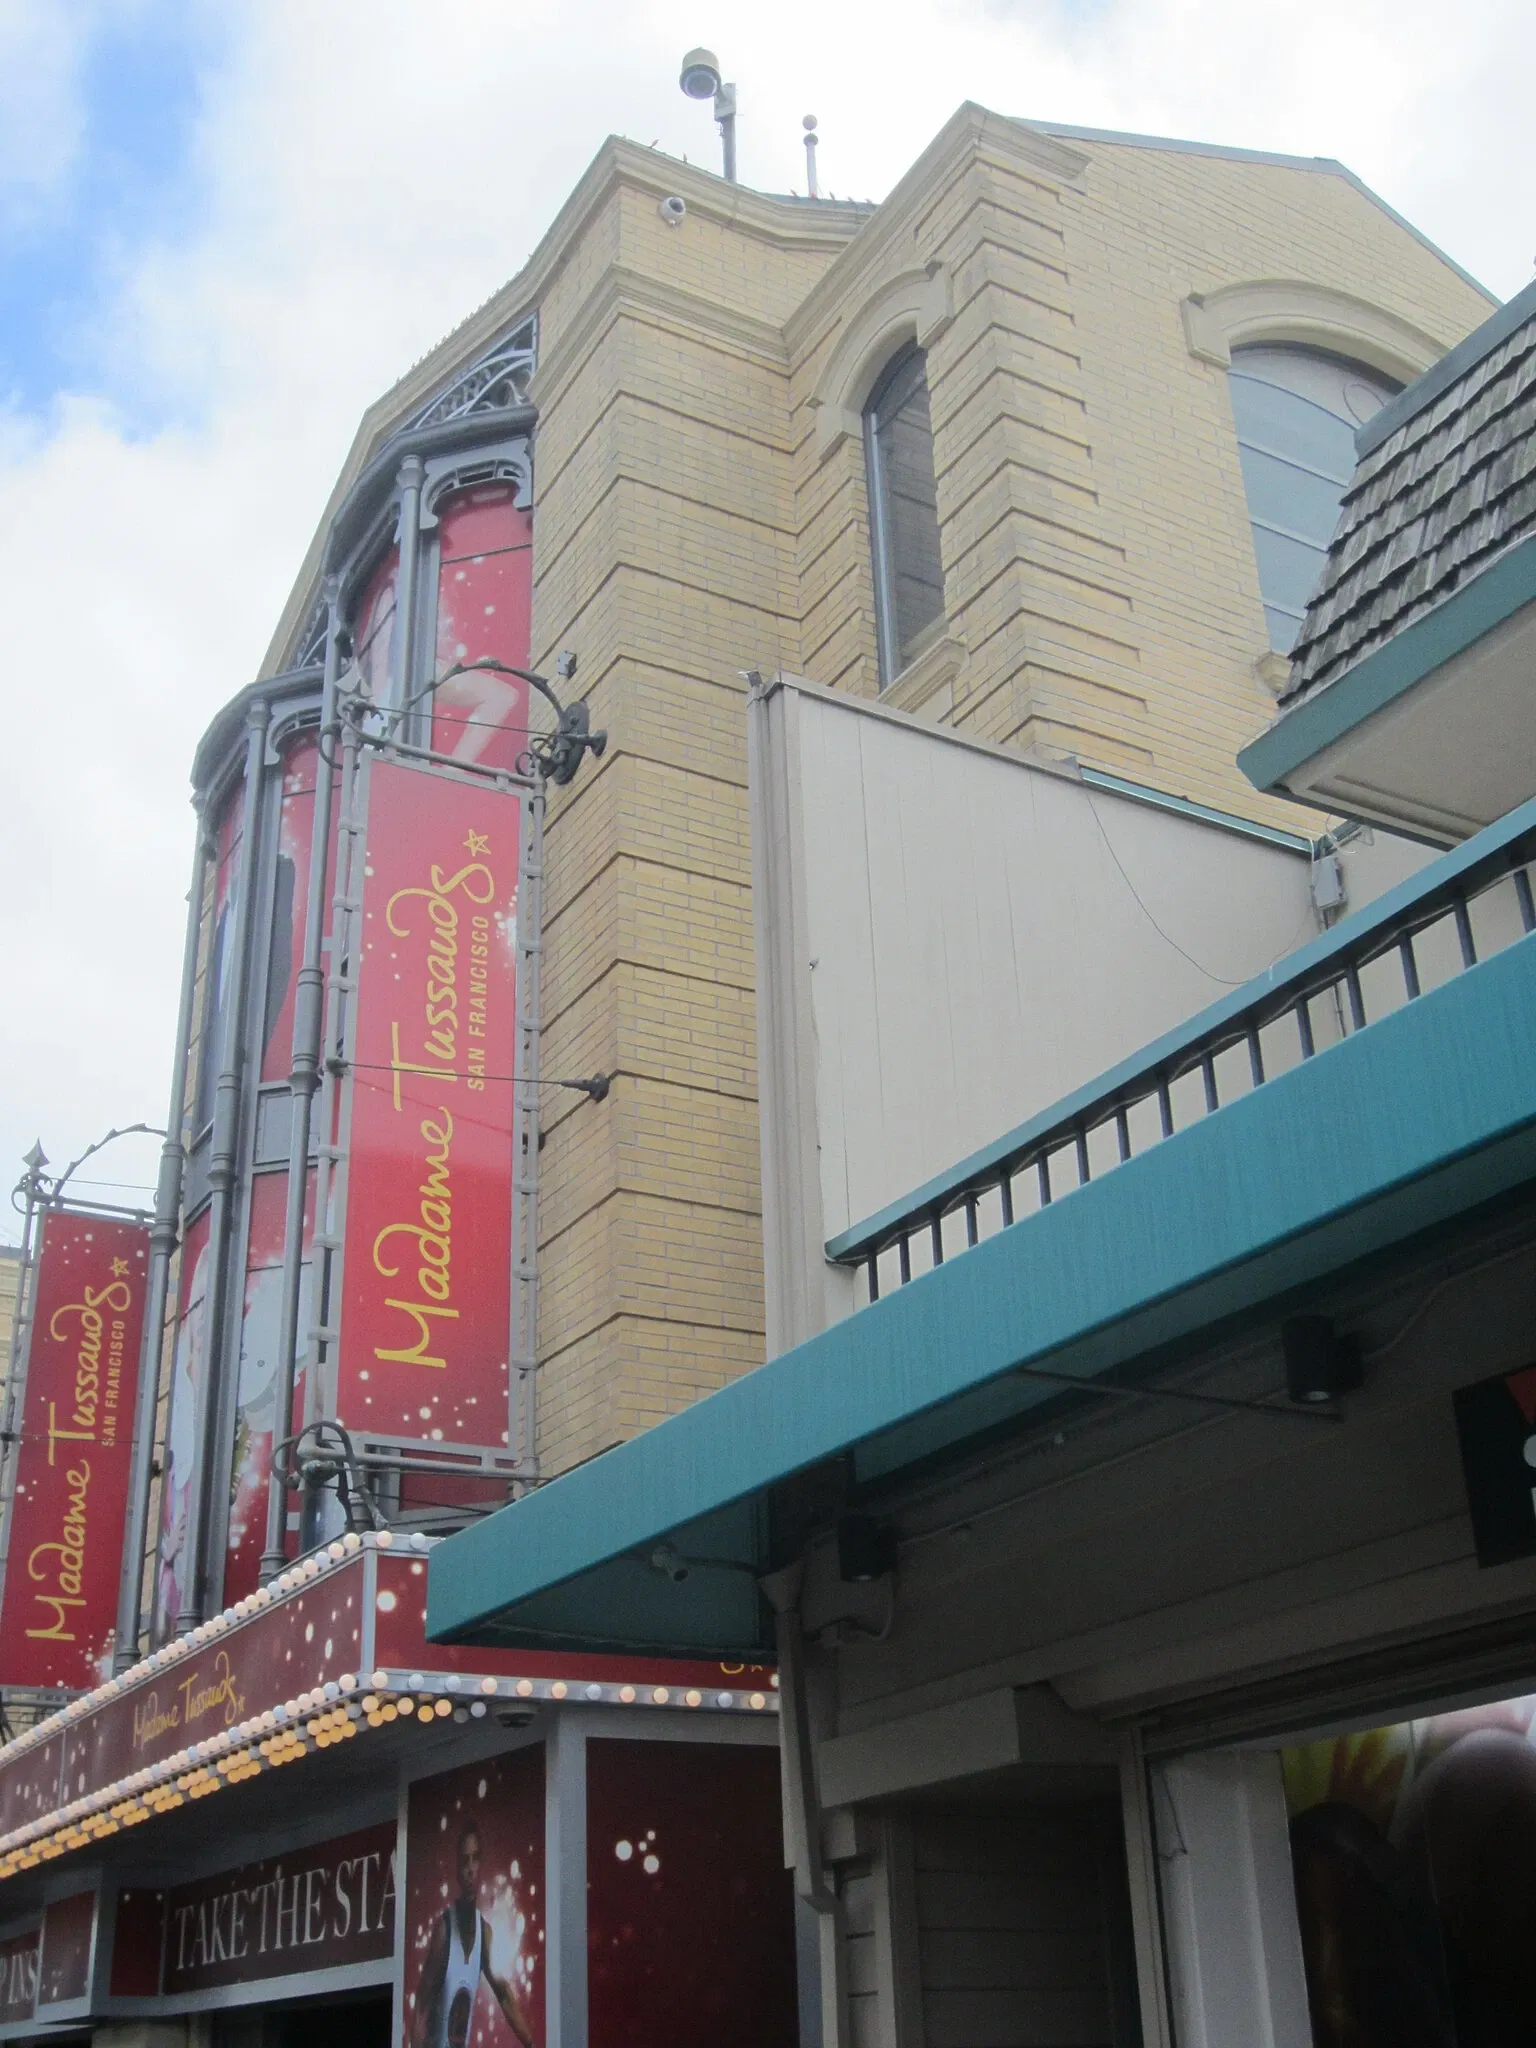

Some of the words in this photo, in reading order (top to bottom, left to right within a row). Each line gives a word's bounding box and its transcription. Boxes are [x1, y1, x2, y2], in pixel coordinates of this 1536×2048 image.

[385, 864, 495, 1111] Tussauds
[469, 916, 490, 1038] FRANCISCO
[467, 1047, 486, 1092] SAN
[373, 1106, 460, 1370] Madame
[48, 1285, 131, 1466] Tussauds
[105, 1319, 126, 1408] FRANCISCO
[101, 1414, 118, 1448] SAN
[25, 1459, 90, 1641] Madame
[132, 1691, 179, 1751] Madame
[175, 1889, 249, 1970] TAKE
[250, 1867, 328, 1953] THE
